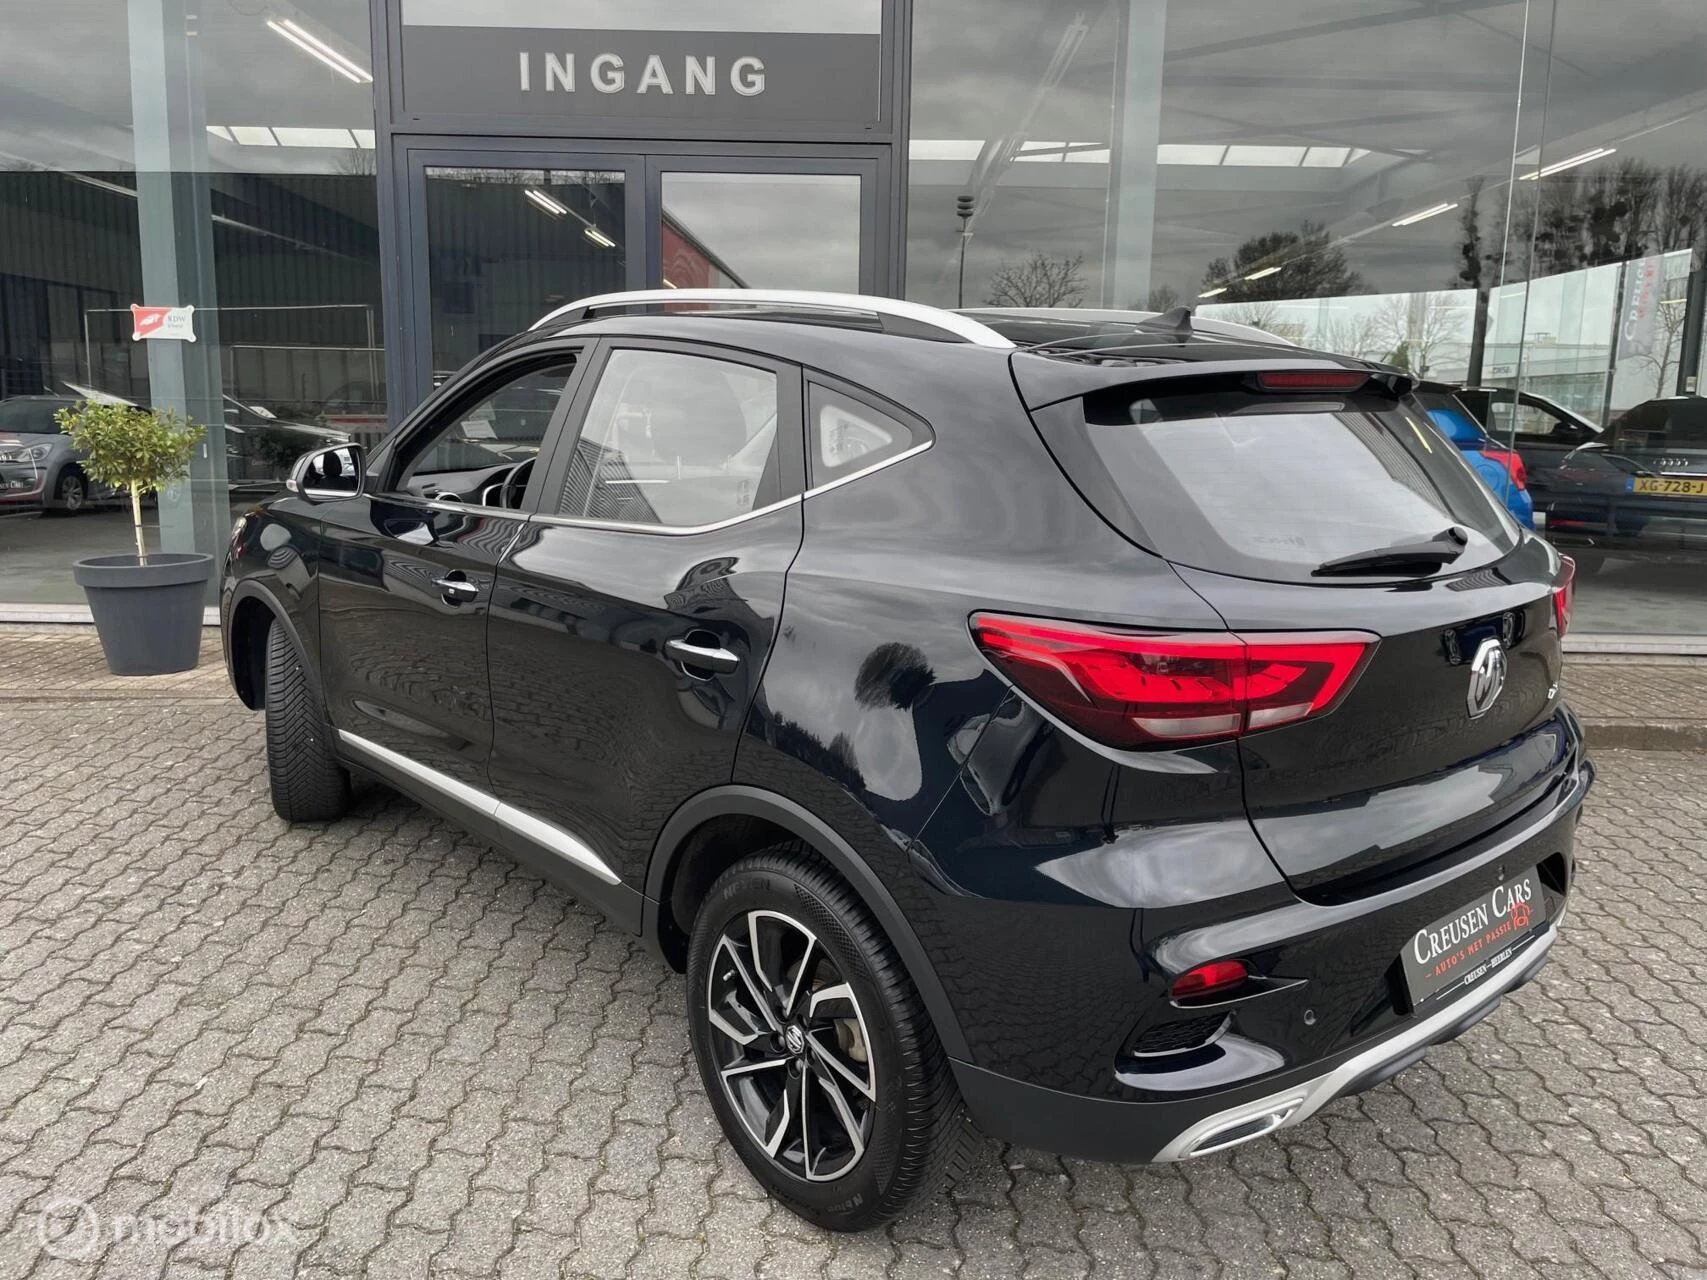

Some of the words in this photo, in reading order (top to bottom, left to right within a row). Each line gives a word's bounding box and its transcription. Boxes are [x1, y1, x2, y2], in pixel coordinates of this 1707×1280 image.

[519, 51, 766, 97] INGANG
[1639, 480, 1704, 494] XG-728-J
[1413, 903, 1489, 964] CREUSEN
[1491, 878, 1532, 918] CARS
[1435, 950, 1465, 976] AUTO'S
[1467, 939, 1483, 955] MET
[1486, 921, 1512, 944] PASSIE
